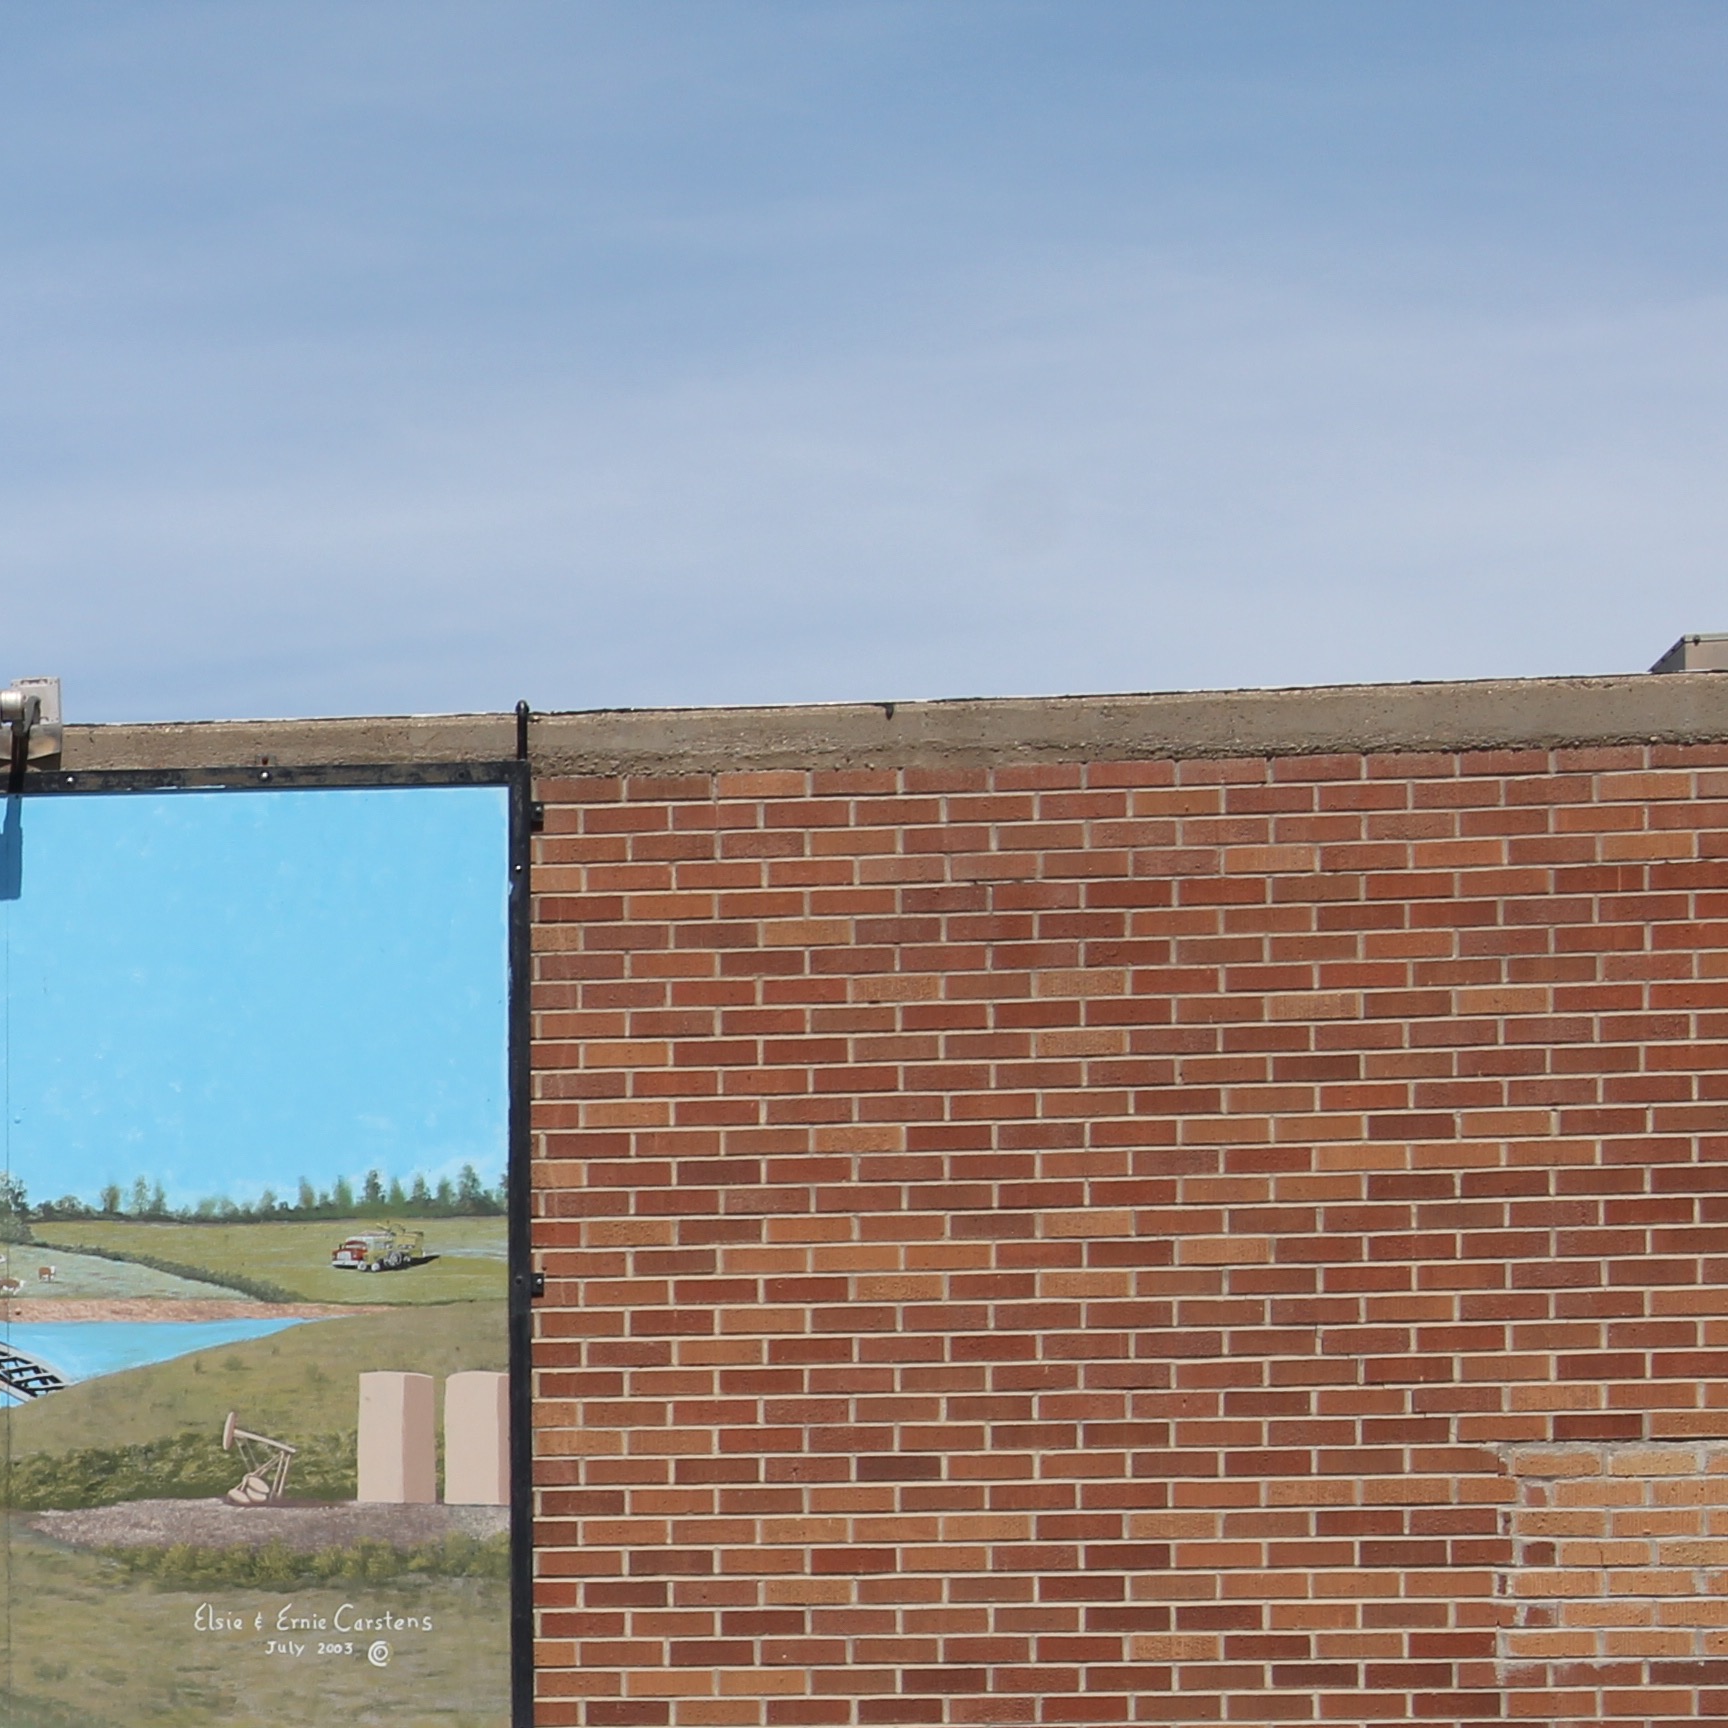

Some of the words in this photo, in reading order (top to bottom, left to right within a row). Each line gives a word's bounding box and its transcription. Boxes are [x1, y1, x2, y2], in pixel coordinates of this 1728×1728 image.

[193, 1602, 243, 1631] Elsie
[254, 1611, 263, 1631] &
[276, 1602, 327, 1631] Ernie
[333, 1603, 433, 1633] Carstens
[264, 1640, 306, 1657] July
[317, 1641, 354, 1655] 2003
